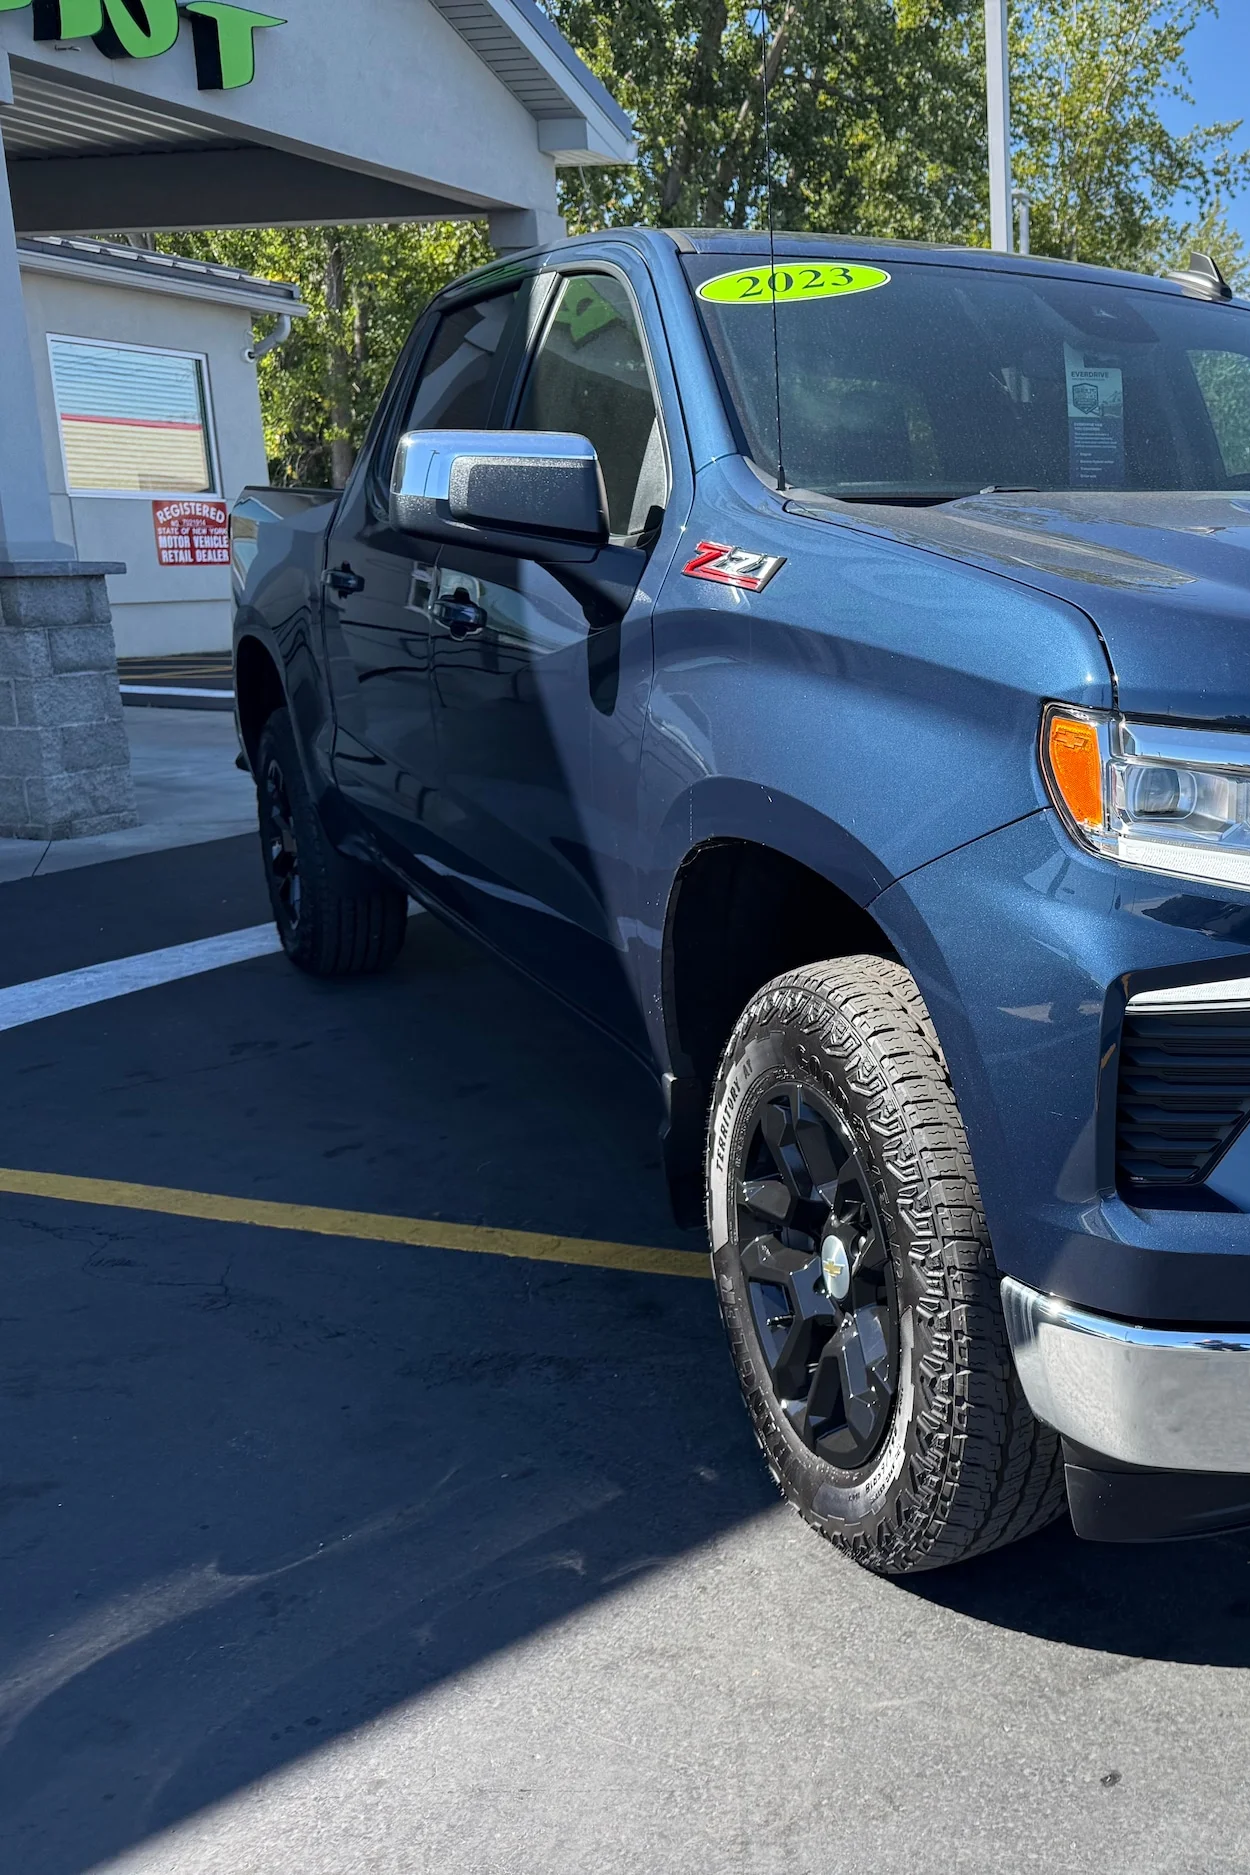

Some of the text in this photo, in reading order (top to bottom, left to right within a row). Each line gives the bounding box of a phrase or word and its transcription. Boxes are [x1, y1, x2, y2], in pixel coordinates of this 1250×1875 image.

[737, 267, 853, 298] 2023
[156, 502, 225, 524] REGISTERED
[159, 535, 229, 549] MOTOR VEHICLE
[161, 549, 229, 563] RETAIL DEALER
[716, 1058, 754, 1173] TERRITORY AT
